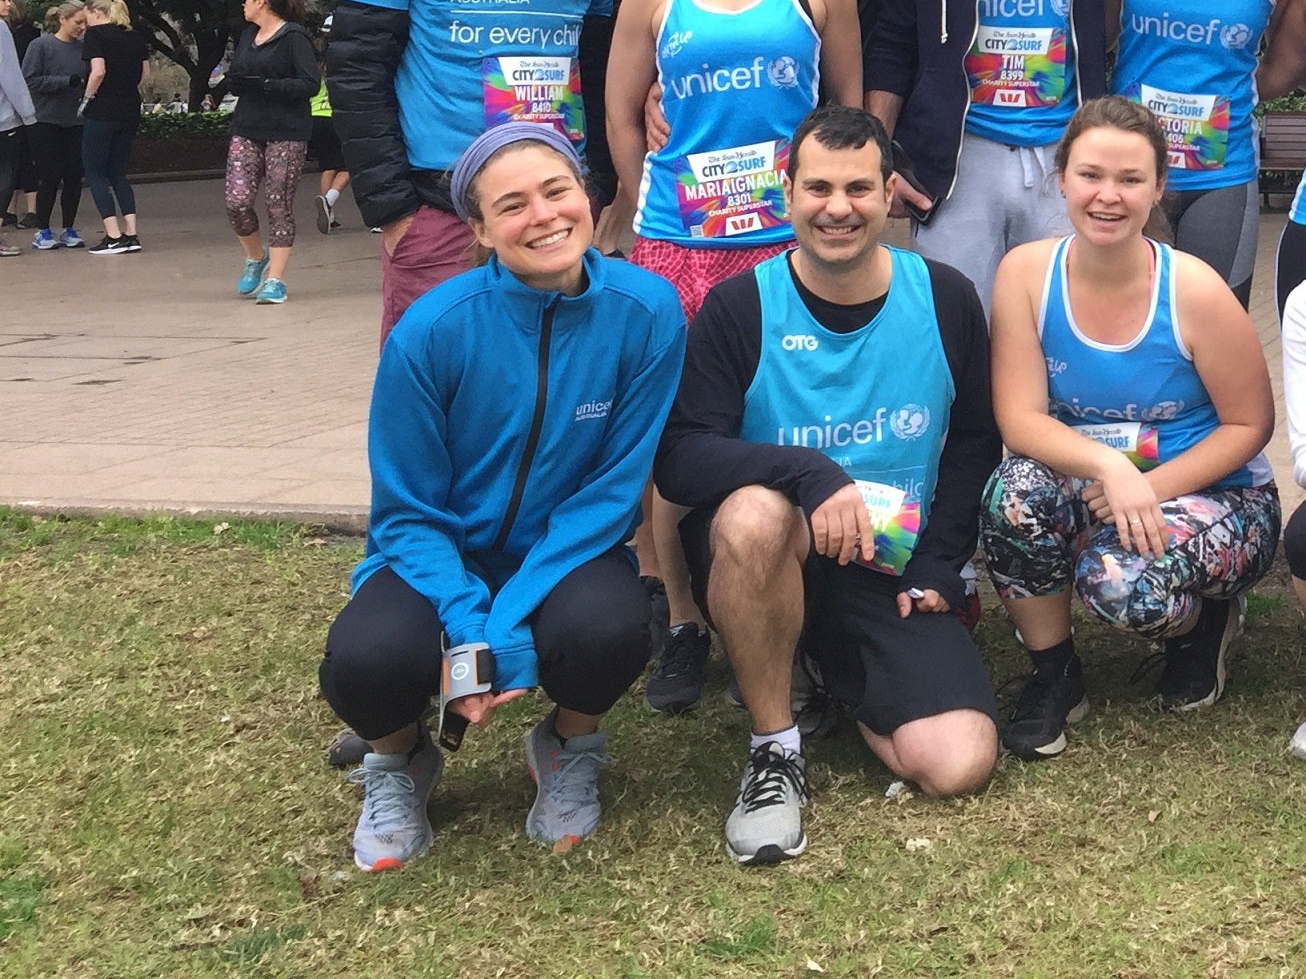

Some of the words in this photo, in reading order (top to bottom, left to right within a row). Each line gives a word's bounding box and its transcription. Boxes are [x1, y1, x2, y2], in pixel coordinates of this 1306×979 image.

[449, 20, 484, 44] for
[489, 26, 551, 50] every
[553, 24, 582, 47] chil
[1132, 12, 1221, 45] unicef
[1002, 55, 1025, 70] TIM
[671, 56, 764, 100] unicef
[1001, 70, 1024, 81] 8399
[514, 85, 564, 101] WILLIAM
[532, 101, 552, 113] 8410
[1157, 116, 1203, 135] CTORIA
[684, 168, 788, 201] MARIAIGNACIA
[727, 193, 752, 208] 8301
[781, 335, 819, 351] OTG
[778, 407, 887, 449] unicef
